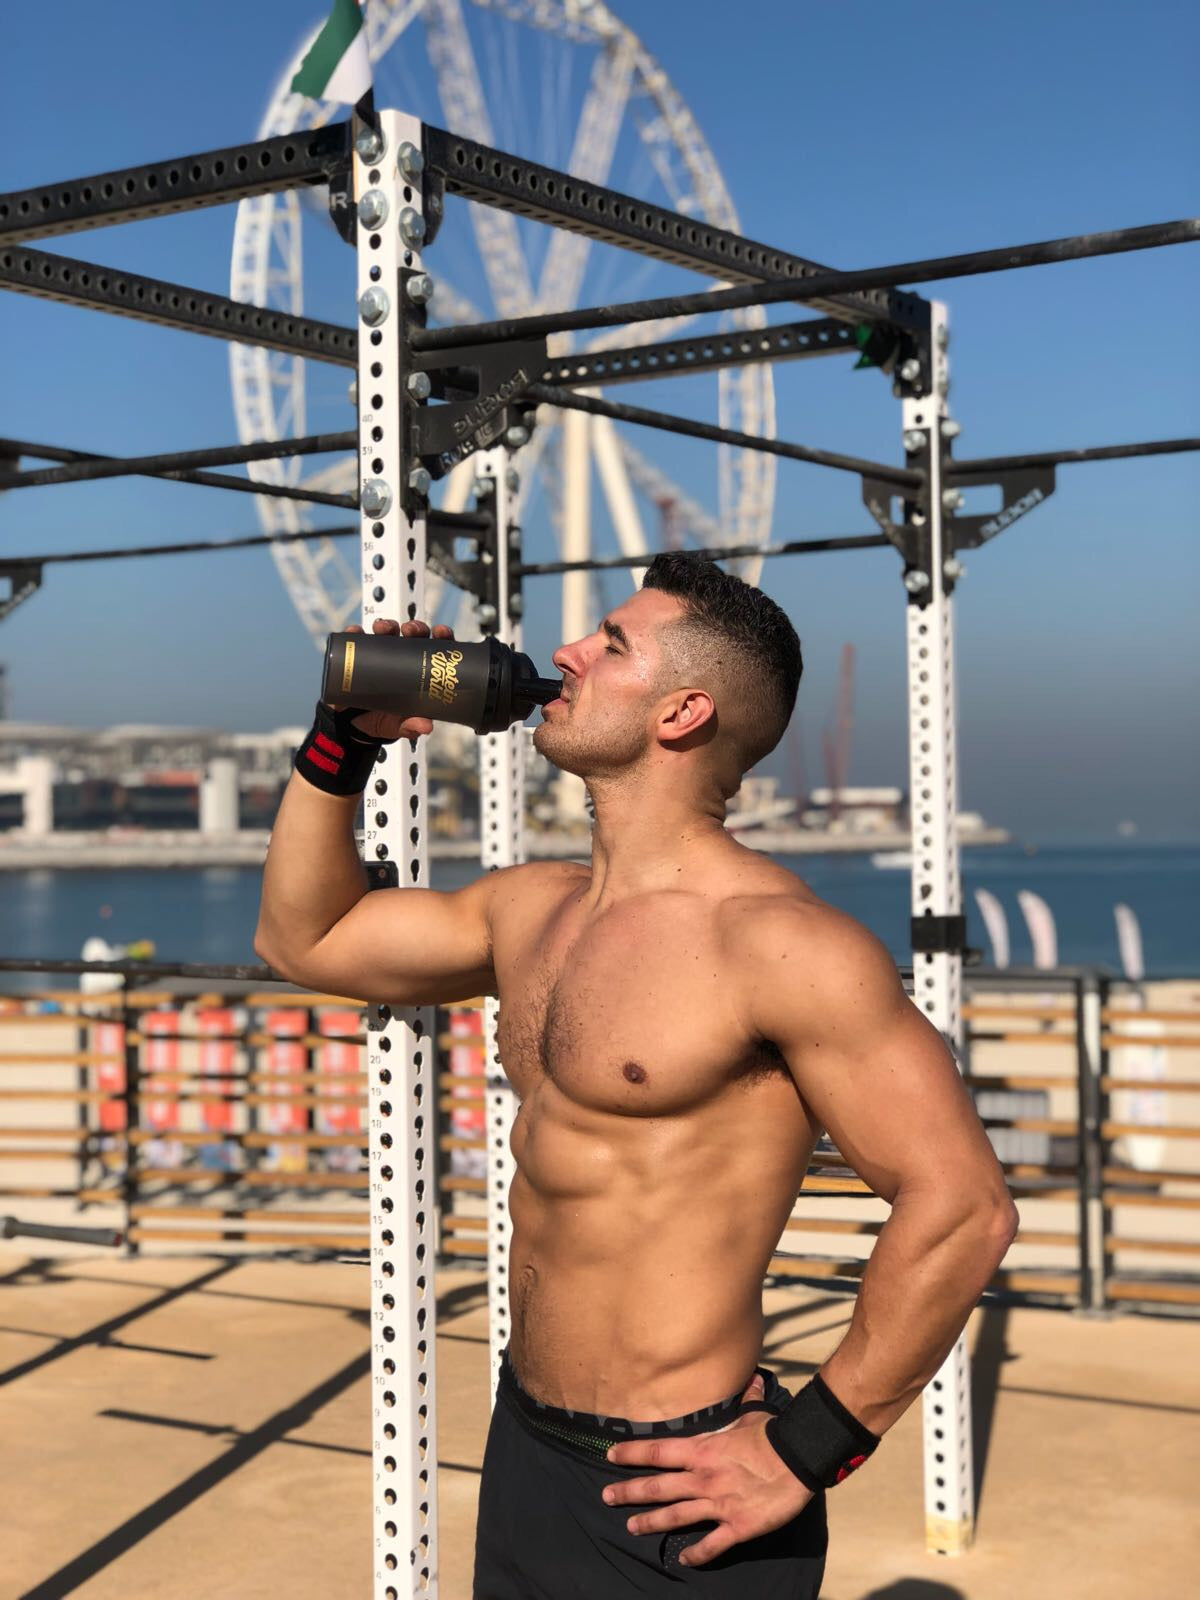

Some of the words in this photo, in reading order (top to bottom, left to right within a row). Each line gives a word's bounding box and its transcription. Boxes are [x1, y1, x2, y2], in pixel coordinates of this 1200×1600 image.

[362, 446, 373, 455] 39
[363, 541, 373, 551] 36
[363, 573, 374, 583] 35
[363, 606, 375, 615] 34
[429, 651, 447, 700] World
[443, 650, 463, 704] Protein
[366, 798, 377, 808] 28
[366, 830, 377, 840] 27
[370, 1055, 381, 1064] 20
[371, 1087, 382, 1096] 19
[371, 1119, 382, 1129] 18
[372, 1151, 382, 1161] 17
[372, 1183, 383, 1193] 16
[373, 1215, 383, 1225] 15
[373, 1247, 384, 1257] 14
[374, 1279, 384, 1289] 13
[374, 1311, 384, 1321] 12
[374, 1344, 385, 1353] 11
[374, 1376, 385, 1386] 10
[374, 1408, 381, 1417] 9
[375, 1473, 381, 1482] 7
